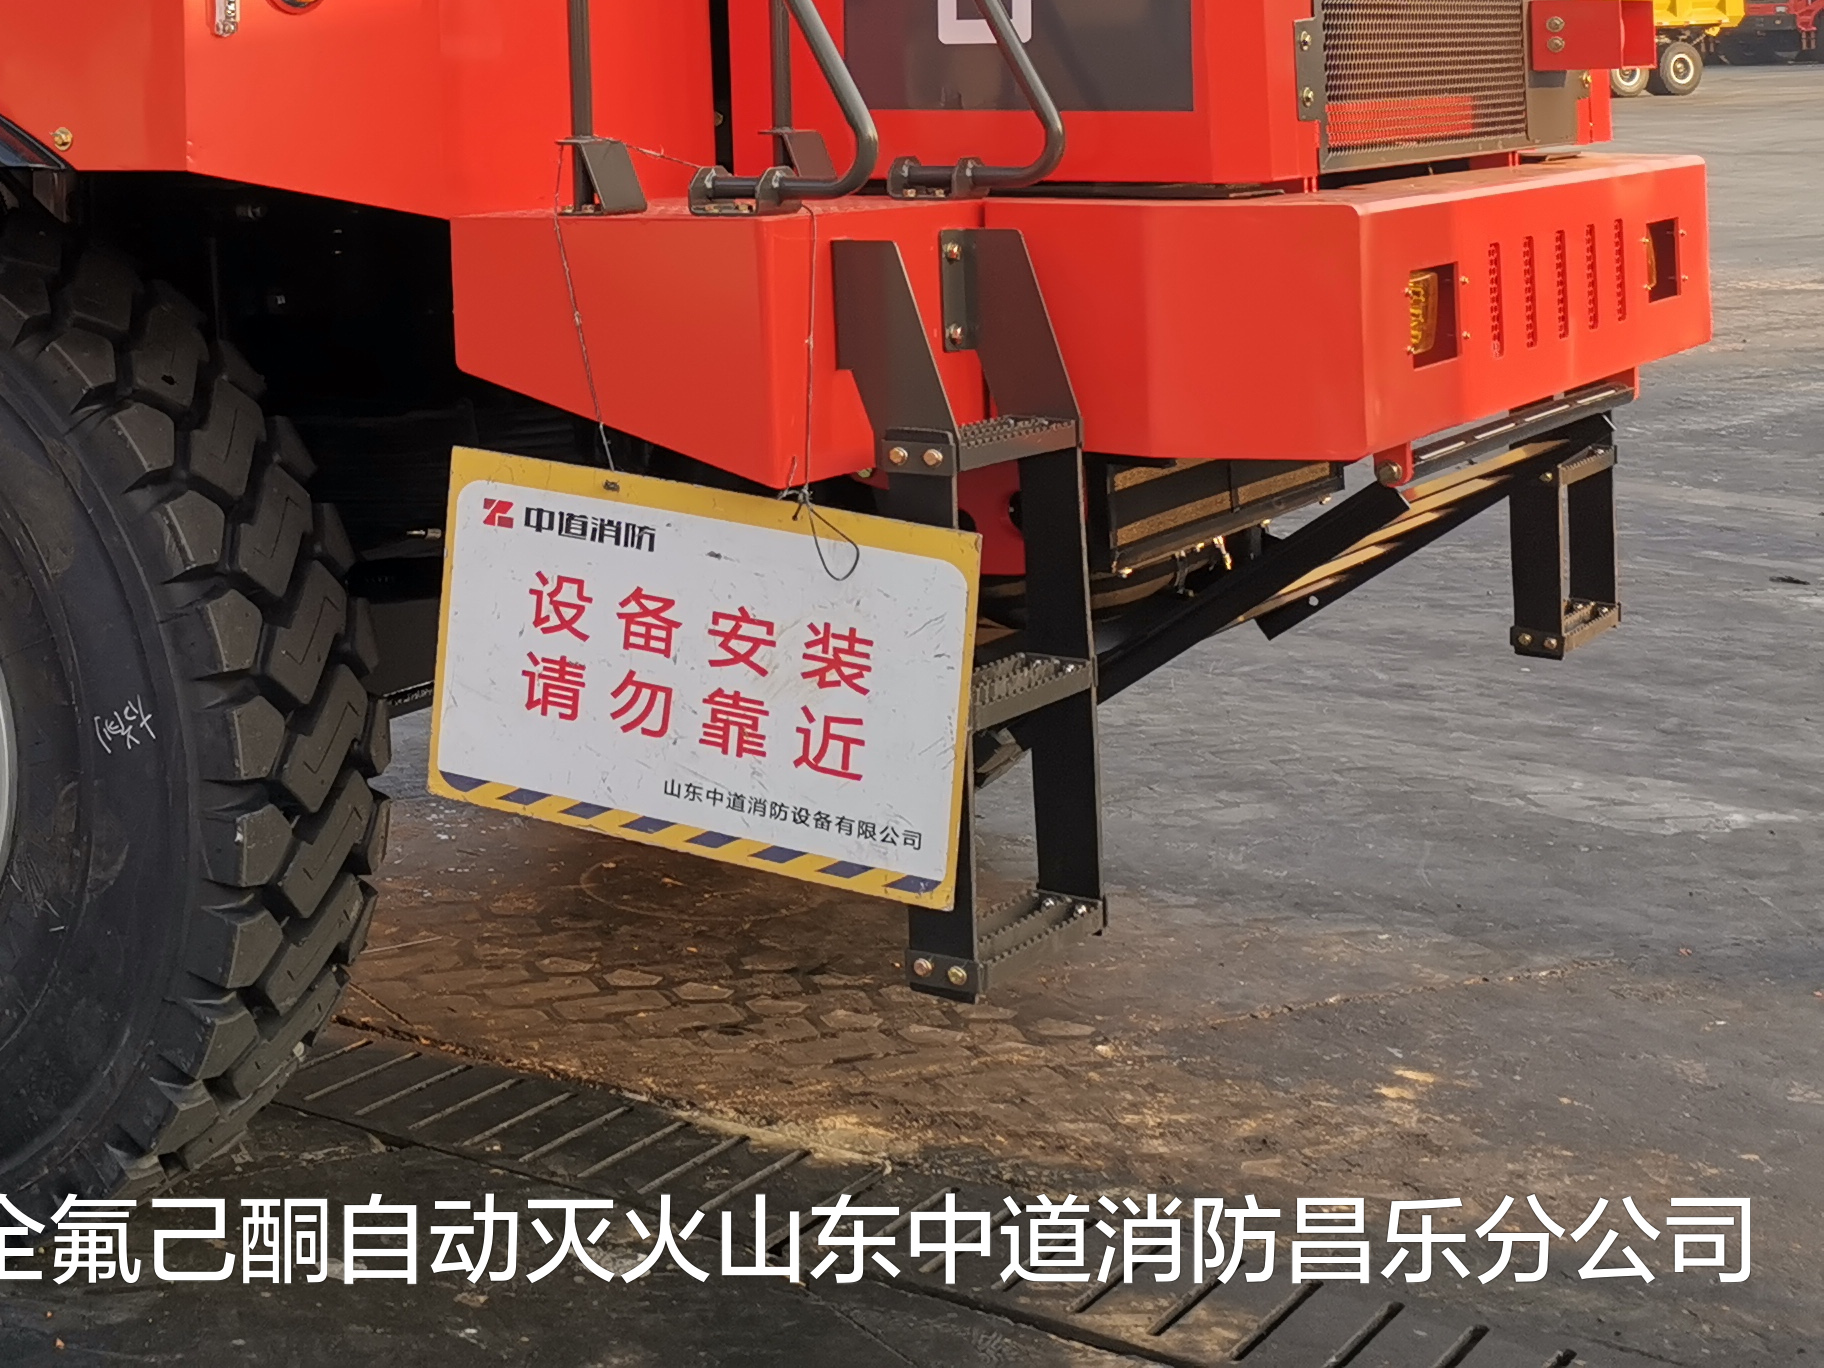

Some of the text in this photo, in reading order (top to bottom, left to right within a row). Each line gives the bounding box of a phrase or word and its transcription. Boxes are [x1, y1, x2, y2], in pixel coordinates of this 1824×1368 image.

[523, 505, 657, 553] 中道消防
[528, 570, 874, 697] 设备安装
[520, 650, 867, 782] 请勿靠近
[663, 778, 924, 851] 山东中道消防设备有限公司
